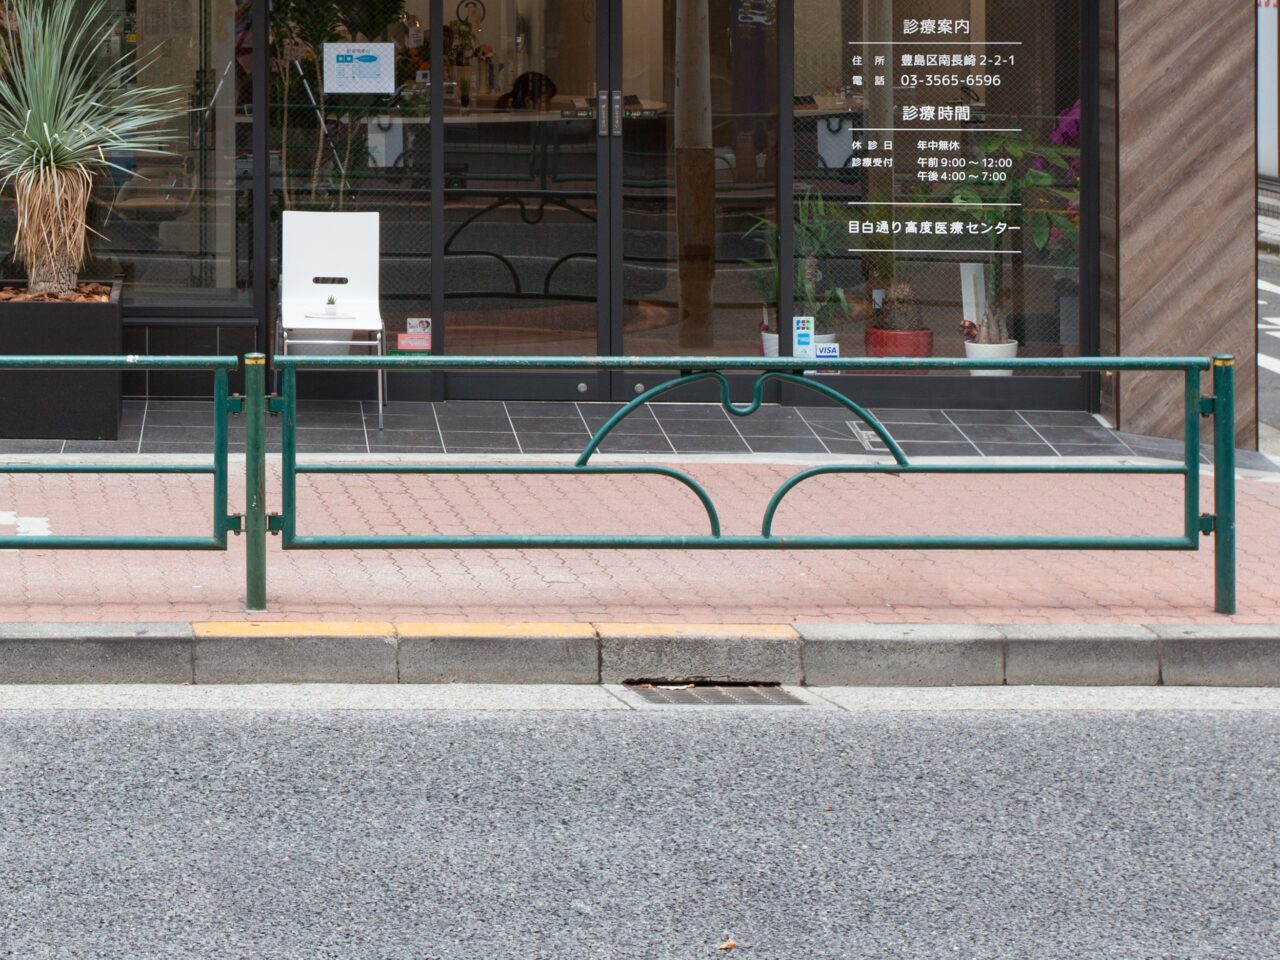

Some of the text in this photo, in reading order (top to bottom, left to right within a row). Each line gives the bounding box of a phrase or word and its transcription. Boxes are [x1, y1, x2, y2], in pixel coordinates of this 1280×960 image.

[903, 19, 970, 35] 診療案内
[979, 55, 1015, 66] 2-2-1
[900, 74, 1002, 86] 03-3565-6596
[902, 105, 970, 121] 診療時間
[917, 140, 960, 151] 年中無休
[851, 157, 893, 168] 診療受付
[981, 158, 1013, 168] 12:00
[981, 171, 1007, 182] 7:00
[848, 220, 1021, 235] 目白通り高度医療センター
[818, 346, 837, 354] VISA
